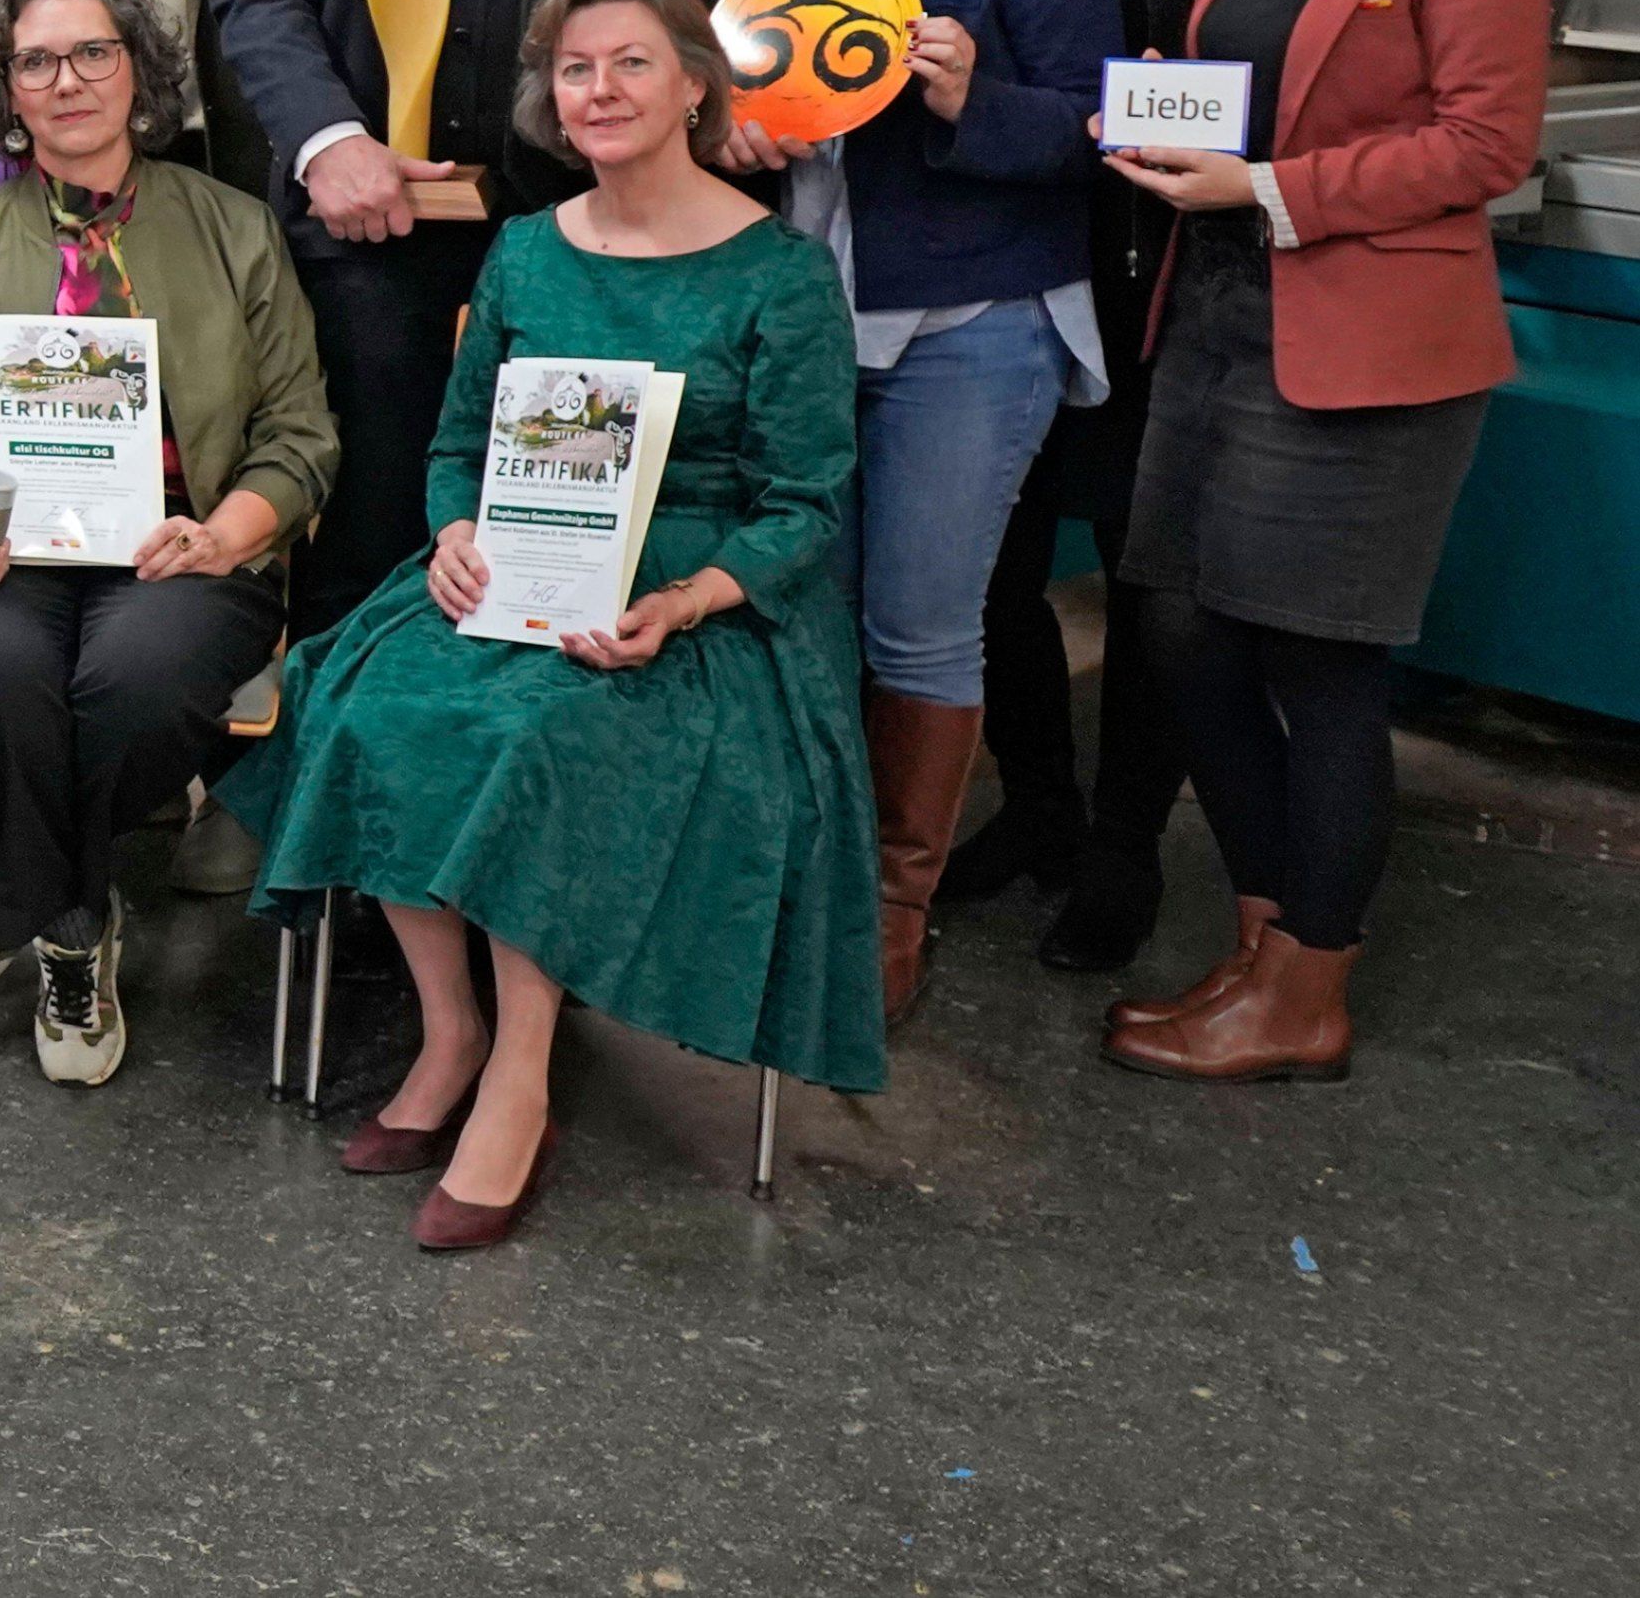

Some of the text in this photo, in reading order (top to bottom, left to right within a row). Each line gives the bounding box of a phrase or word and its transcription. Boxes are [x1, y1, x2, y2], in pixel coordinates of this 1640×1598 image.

[1126, 88, 1222, 121] Liebe
[31, 375, 70, 385] ROUTE
[34, 445, 90, 456] tischkultur
[92, 447, 110, 457] OG
[495, 457, 623, 484] ZERTIFIKAT
[490, 508, 530, 521] Stephanus
